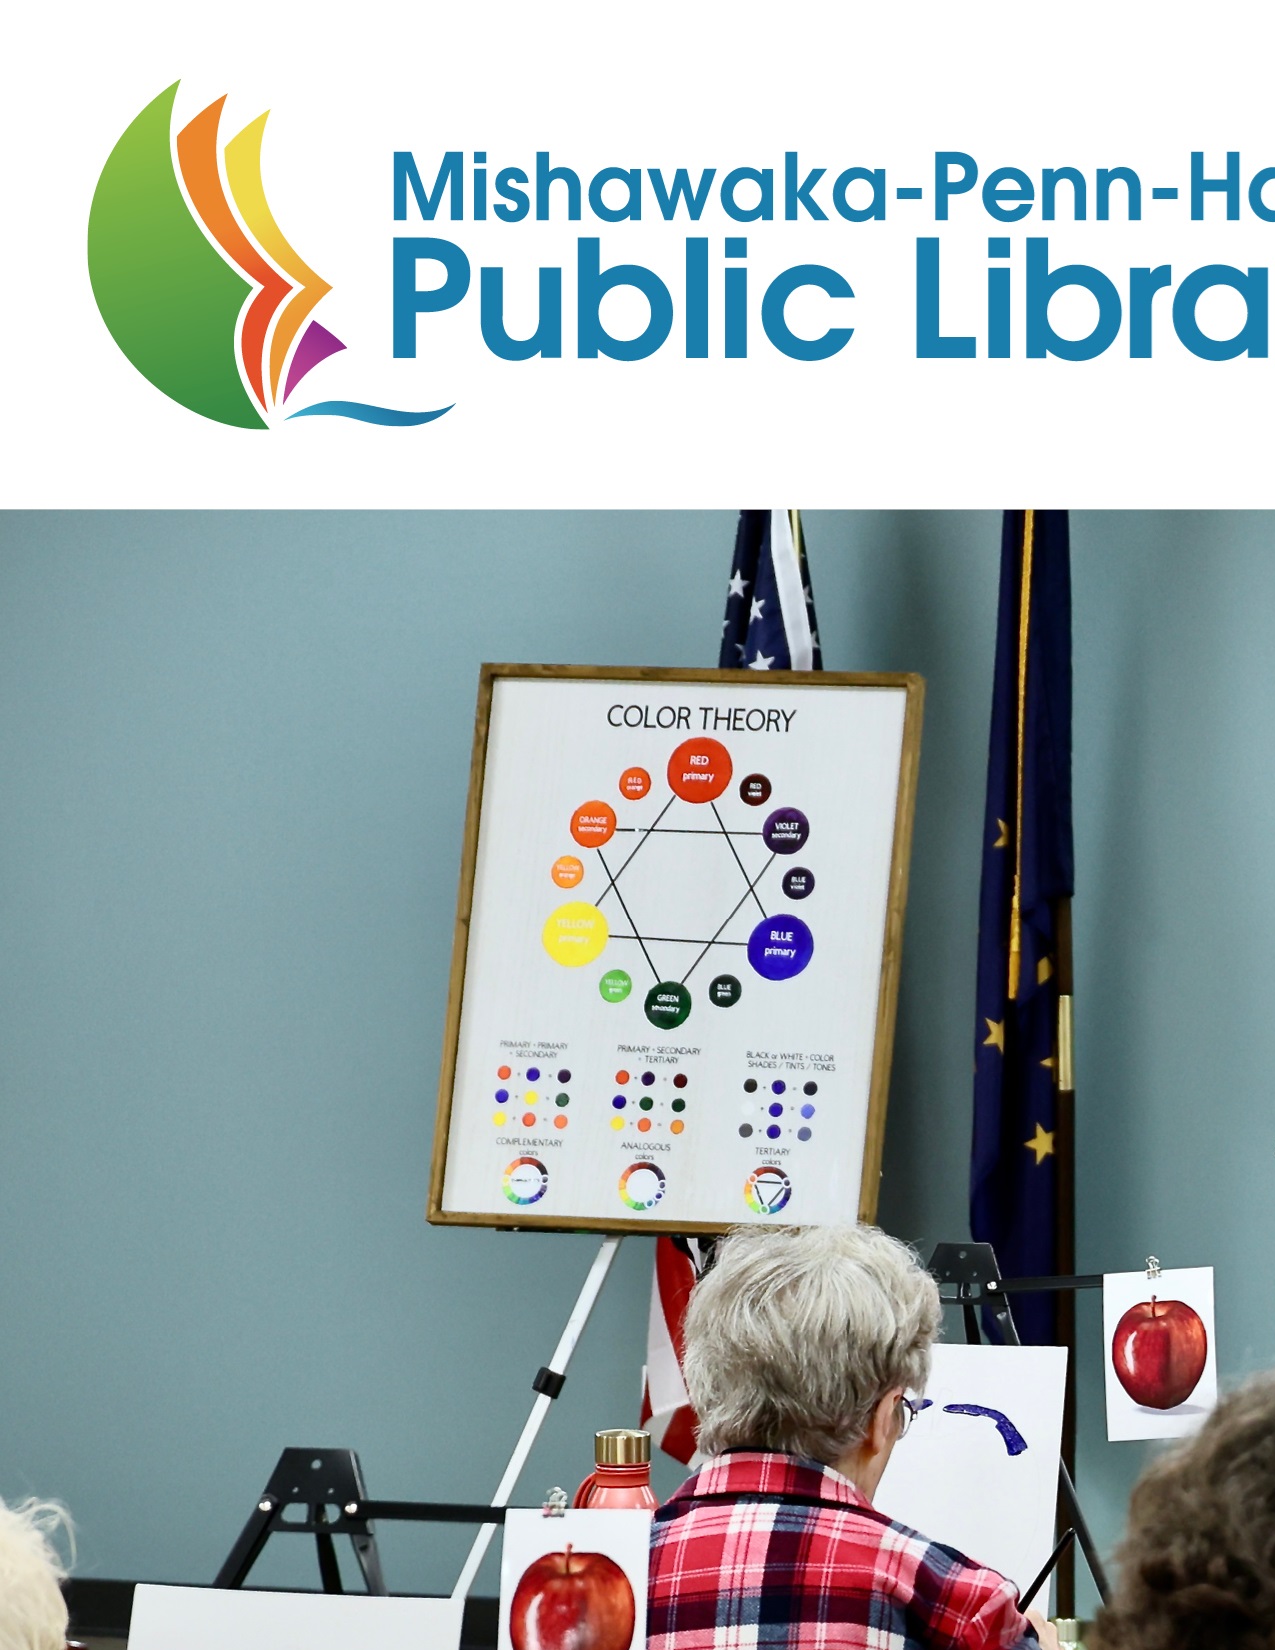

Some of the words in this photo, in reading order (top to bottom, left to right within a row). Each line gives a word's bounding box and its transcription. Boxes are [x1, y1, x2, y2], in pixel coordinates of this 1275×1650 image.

[607, 704, 691, 730] COLOR
[699, 706, 797, 733] THEORY
[690, 755, 709, 766] RED
[682, 772, 714, 783] primary
[579, 816, 607, 824] ORANGE
[775, 822, 799, 831] VIOLET
[556, 918, 595, 929] YELLOW
[770, 930, 793, 942] BLUE
[764, 946, 796, 958] primary
[657, 994, 679, 1003] GREEN
[746, 1050, 770, 1059] BLACK
[780, 1052, 803, 1061] WHITE
[748, 1060, 777, 1069] SHADES
[496, 1136, 564, 1148] COMPLEMENTARY
[621, 1141, 671, 1152] ANALOGOUS
[755, 1147, 791, 1156] TERTIARY
